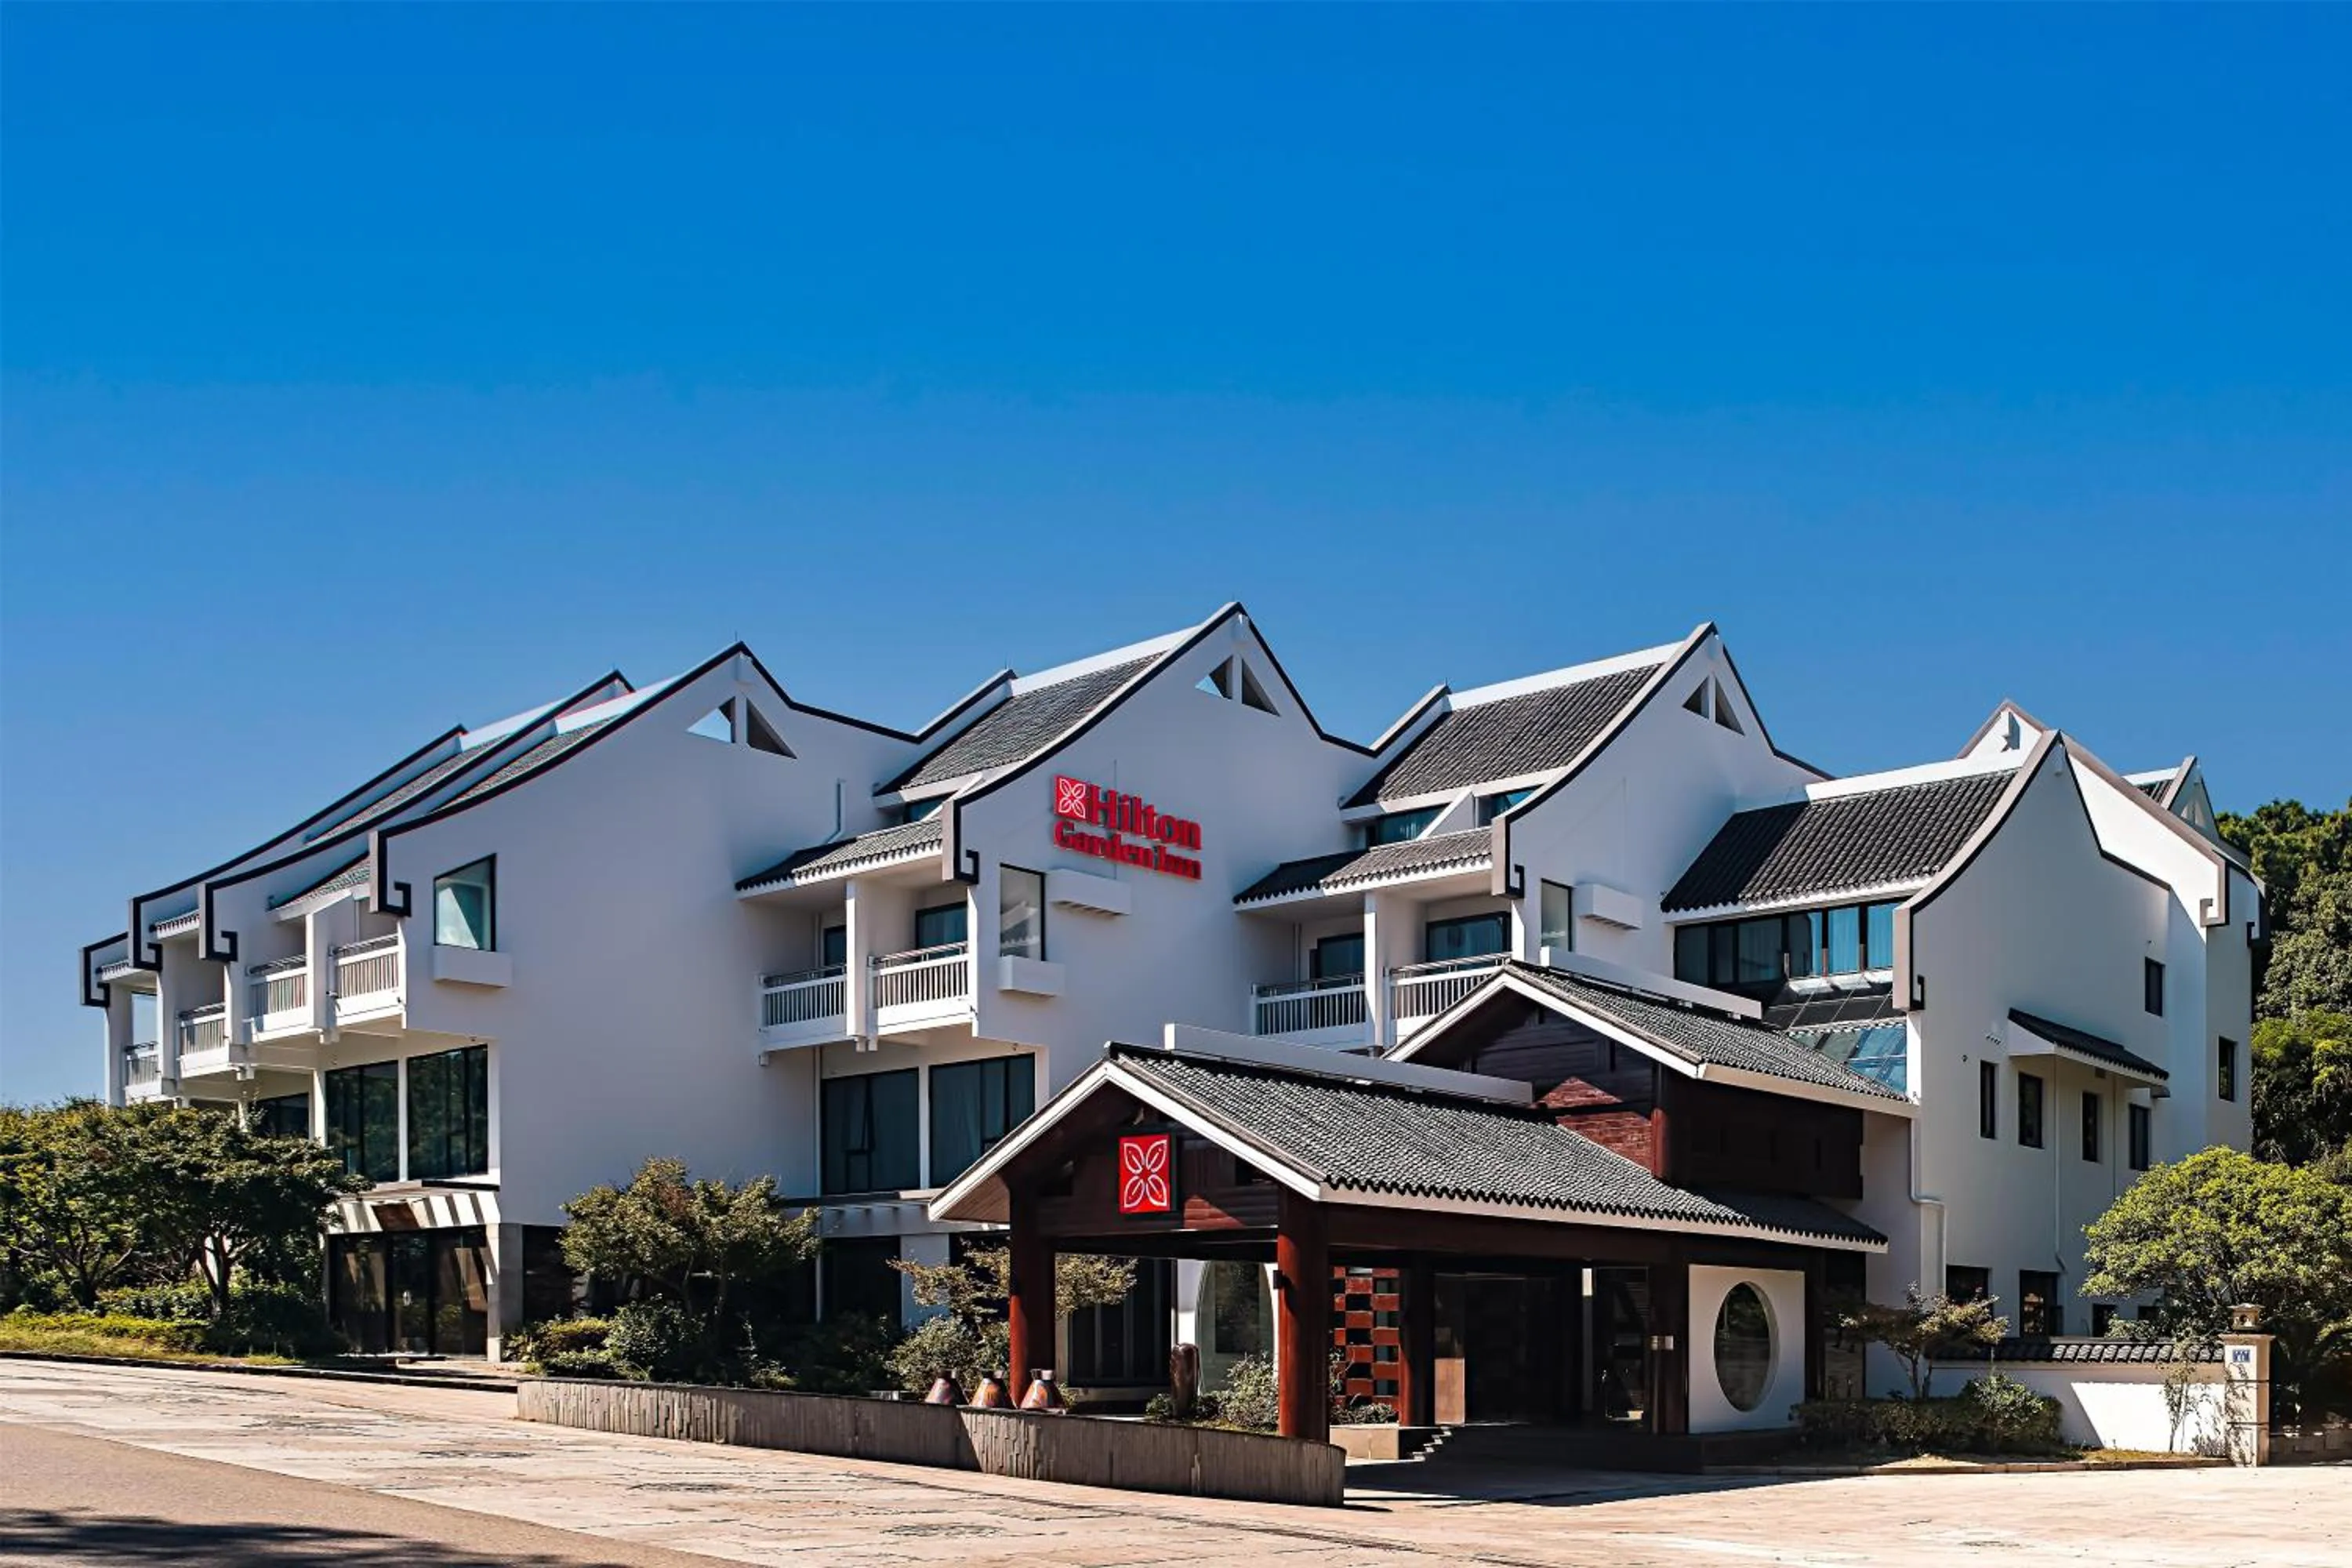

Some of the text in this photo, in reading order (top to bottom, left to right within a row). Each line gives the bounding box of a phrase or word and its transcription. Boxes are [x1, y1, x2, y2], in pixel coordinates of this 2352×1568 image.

[1090, 784, 1202, 850] Hilton
[1053, 821, 1202, 880] Garden Inn
